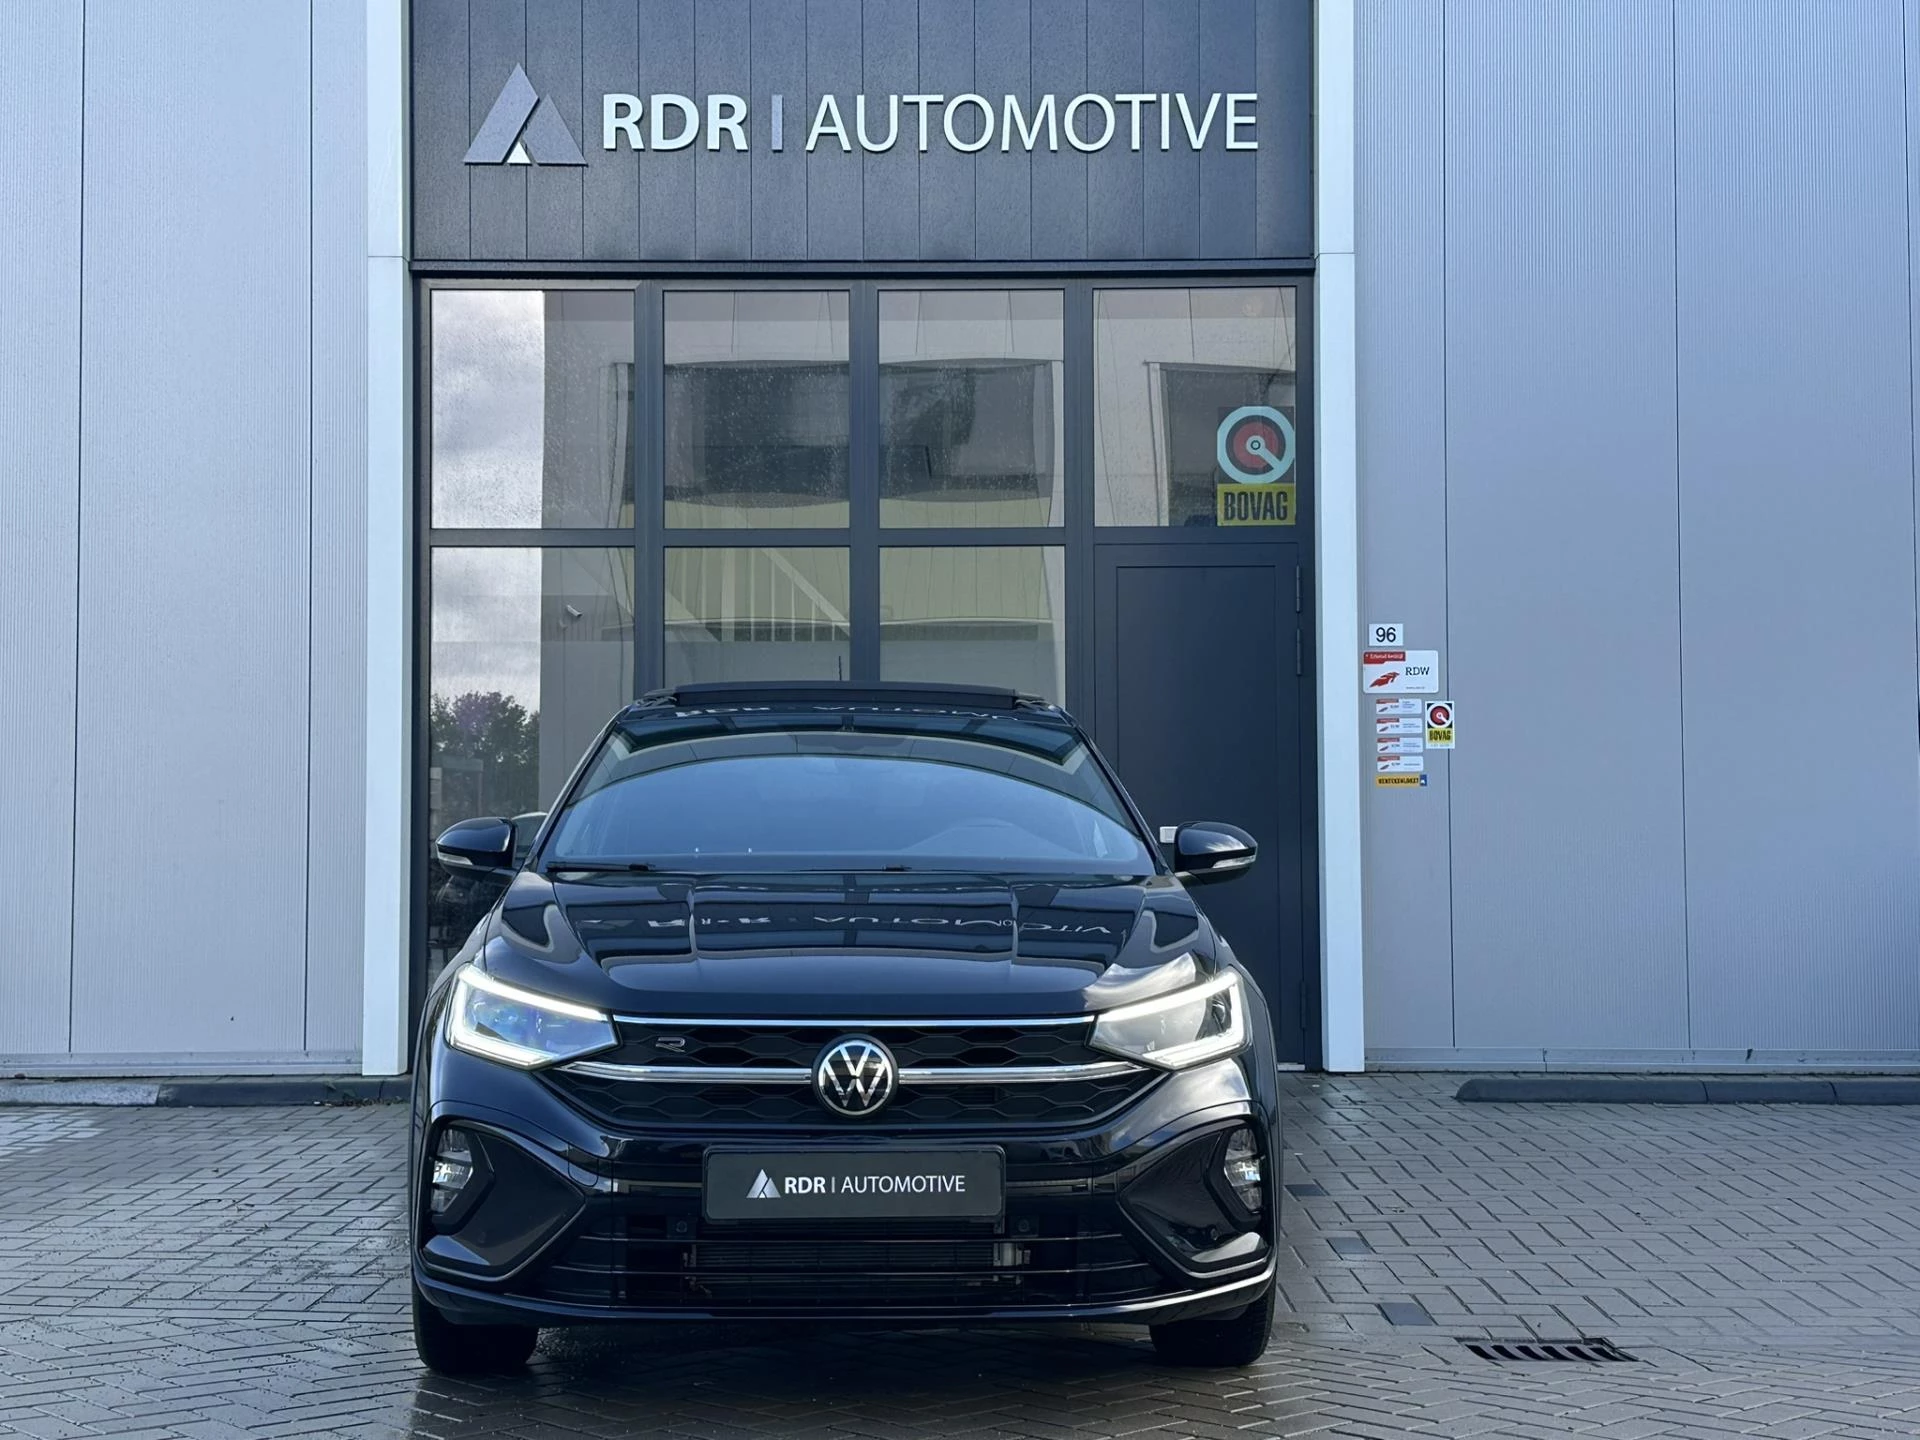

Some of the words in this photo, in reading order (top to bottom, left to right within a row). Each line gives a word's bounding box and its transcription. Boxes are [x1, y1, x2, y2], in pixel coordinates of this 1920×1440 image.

[603, 94, 748, 150] RDR
[806, 93, 1259, 152] AUTOMOTIVE
[1223, 491, 1288, 521] BOVAG
[1375, 627, 1397, 643] 96
[1405, 666, 1430, 676] RDW
[1429, 731, 1451, 741] BOVAG
[785, 1176, 826, 1194] RDR
[841, 1175, 966, 1194] AUTOMOTIVE
